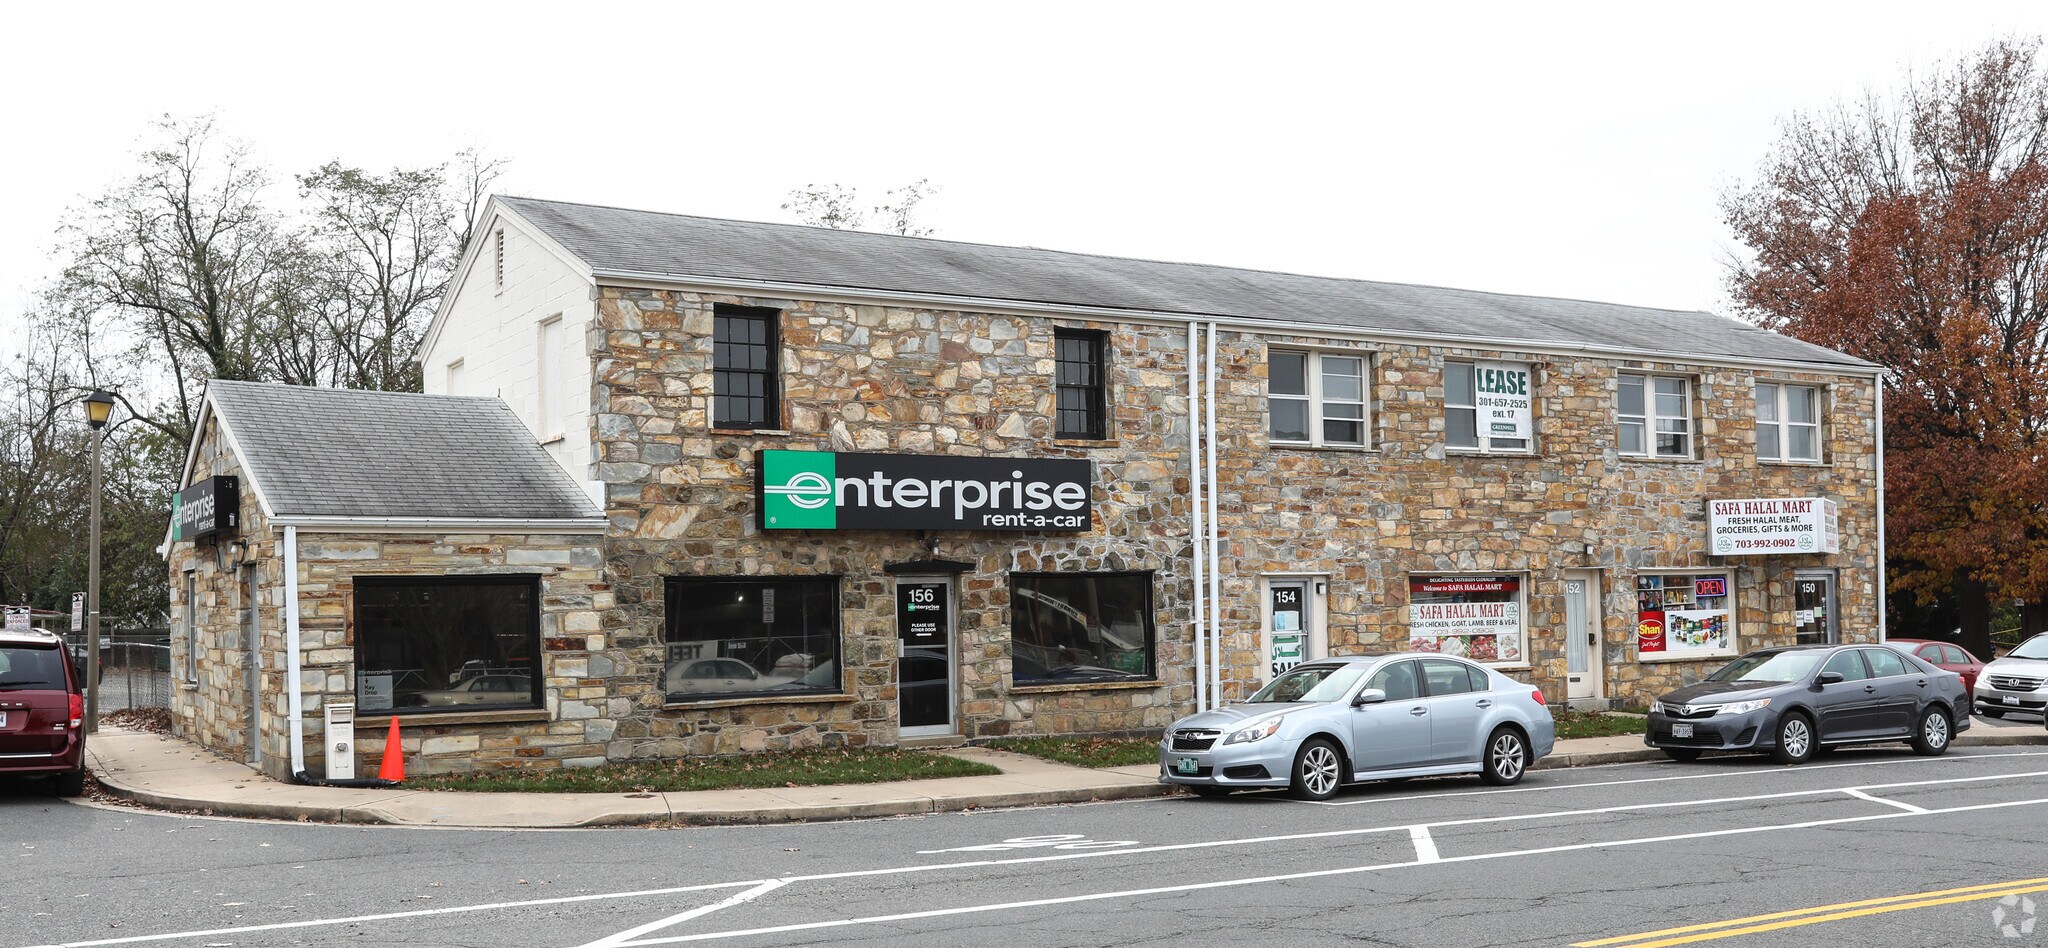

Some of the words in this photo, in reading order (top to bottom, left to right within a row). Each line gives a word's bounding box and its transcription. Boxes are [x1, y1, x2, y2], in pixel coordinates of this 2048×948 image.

[1476, 368, 1527, 395] LEASE
[1478, 397, 1528, 409] 301-657-2525
[1492, 410, 1506, 418] ext.
[1507, 410, 1515, 418] 17
[765, 470, 1086, 520] enterprise
[173, 490, 214, 528] enterprise
[1715, 502, 1741, 515] SAFA
[1744, 501, 1779, 514] HALAL
[1782, 500, 1812, 513] MART
[199, 518, 215, 531] rent-a-car
[982, 511, 1085, 527] rent-a-car
[1727, 516, 1751, 525] FRESH
[1753, 516, 1777, 524] HALAL
[1779, 515, 1801, 524] MEAT,
[1716, 525, 1760, 535] GROCERIES,
[1761, 525, 1782, 533] GIFTS
[1783, 524, 1790, 532] &
[1791, 524, 1813, 532] MORE
[1735, 538, 1796, 549] 703-992-0902
[1565, 583, 1580, 593] 152
[1696, 581, 1724, 594] OPEN
[1802, 583, 1815, 593] 150
[908, 589, 934, 602] 156
[1276, 591, 1296, 603] 154
[1420, 605, 1442, 619] SAFA
[1446, 604, 1477, 618] HALAL
[1480, 604, 1505, 617] MART
[1639, 624, 1660, 634] Shan
